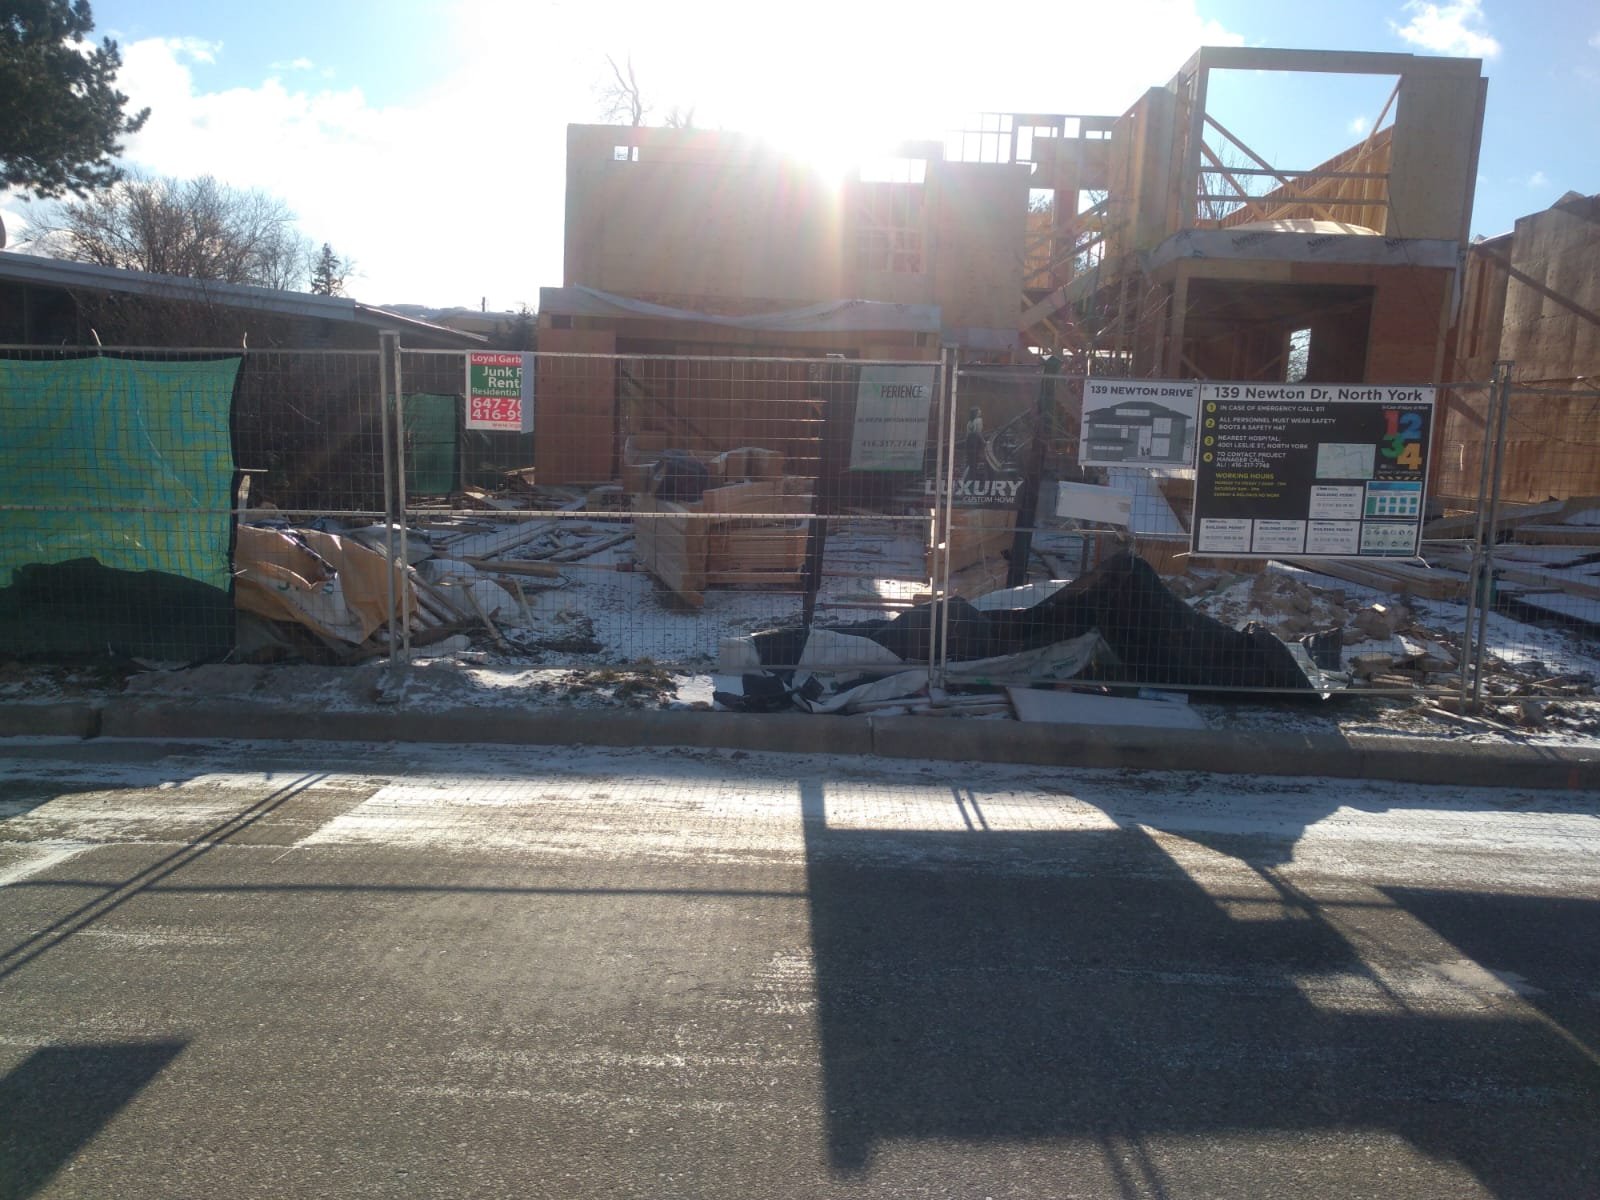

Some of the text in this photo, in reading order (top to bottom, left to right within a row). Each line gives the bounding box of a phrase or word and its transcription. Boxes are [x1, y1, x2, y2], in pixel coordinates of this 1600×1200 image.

[472, 354, 497, 363] Loyal
[482, 366, 513, 377] Junk
[472, 387, 519, 397] Residential
[1091, 385, 1193, 397] 139 NEWTON DRIVE
[1214, 387, 1423, 401] 139 Newton Dr, North York
[1385, 410, 1423, 440] 1 2
[1381, 433, 1423, 470] 3 4
[994, 496, 1016, 504] HOME
